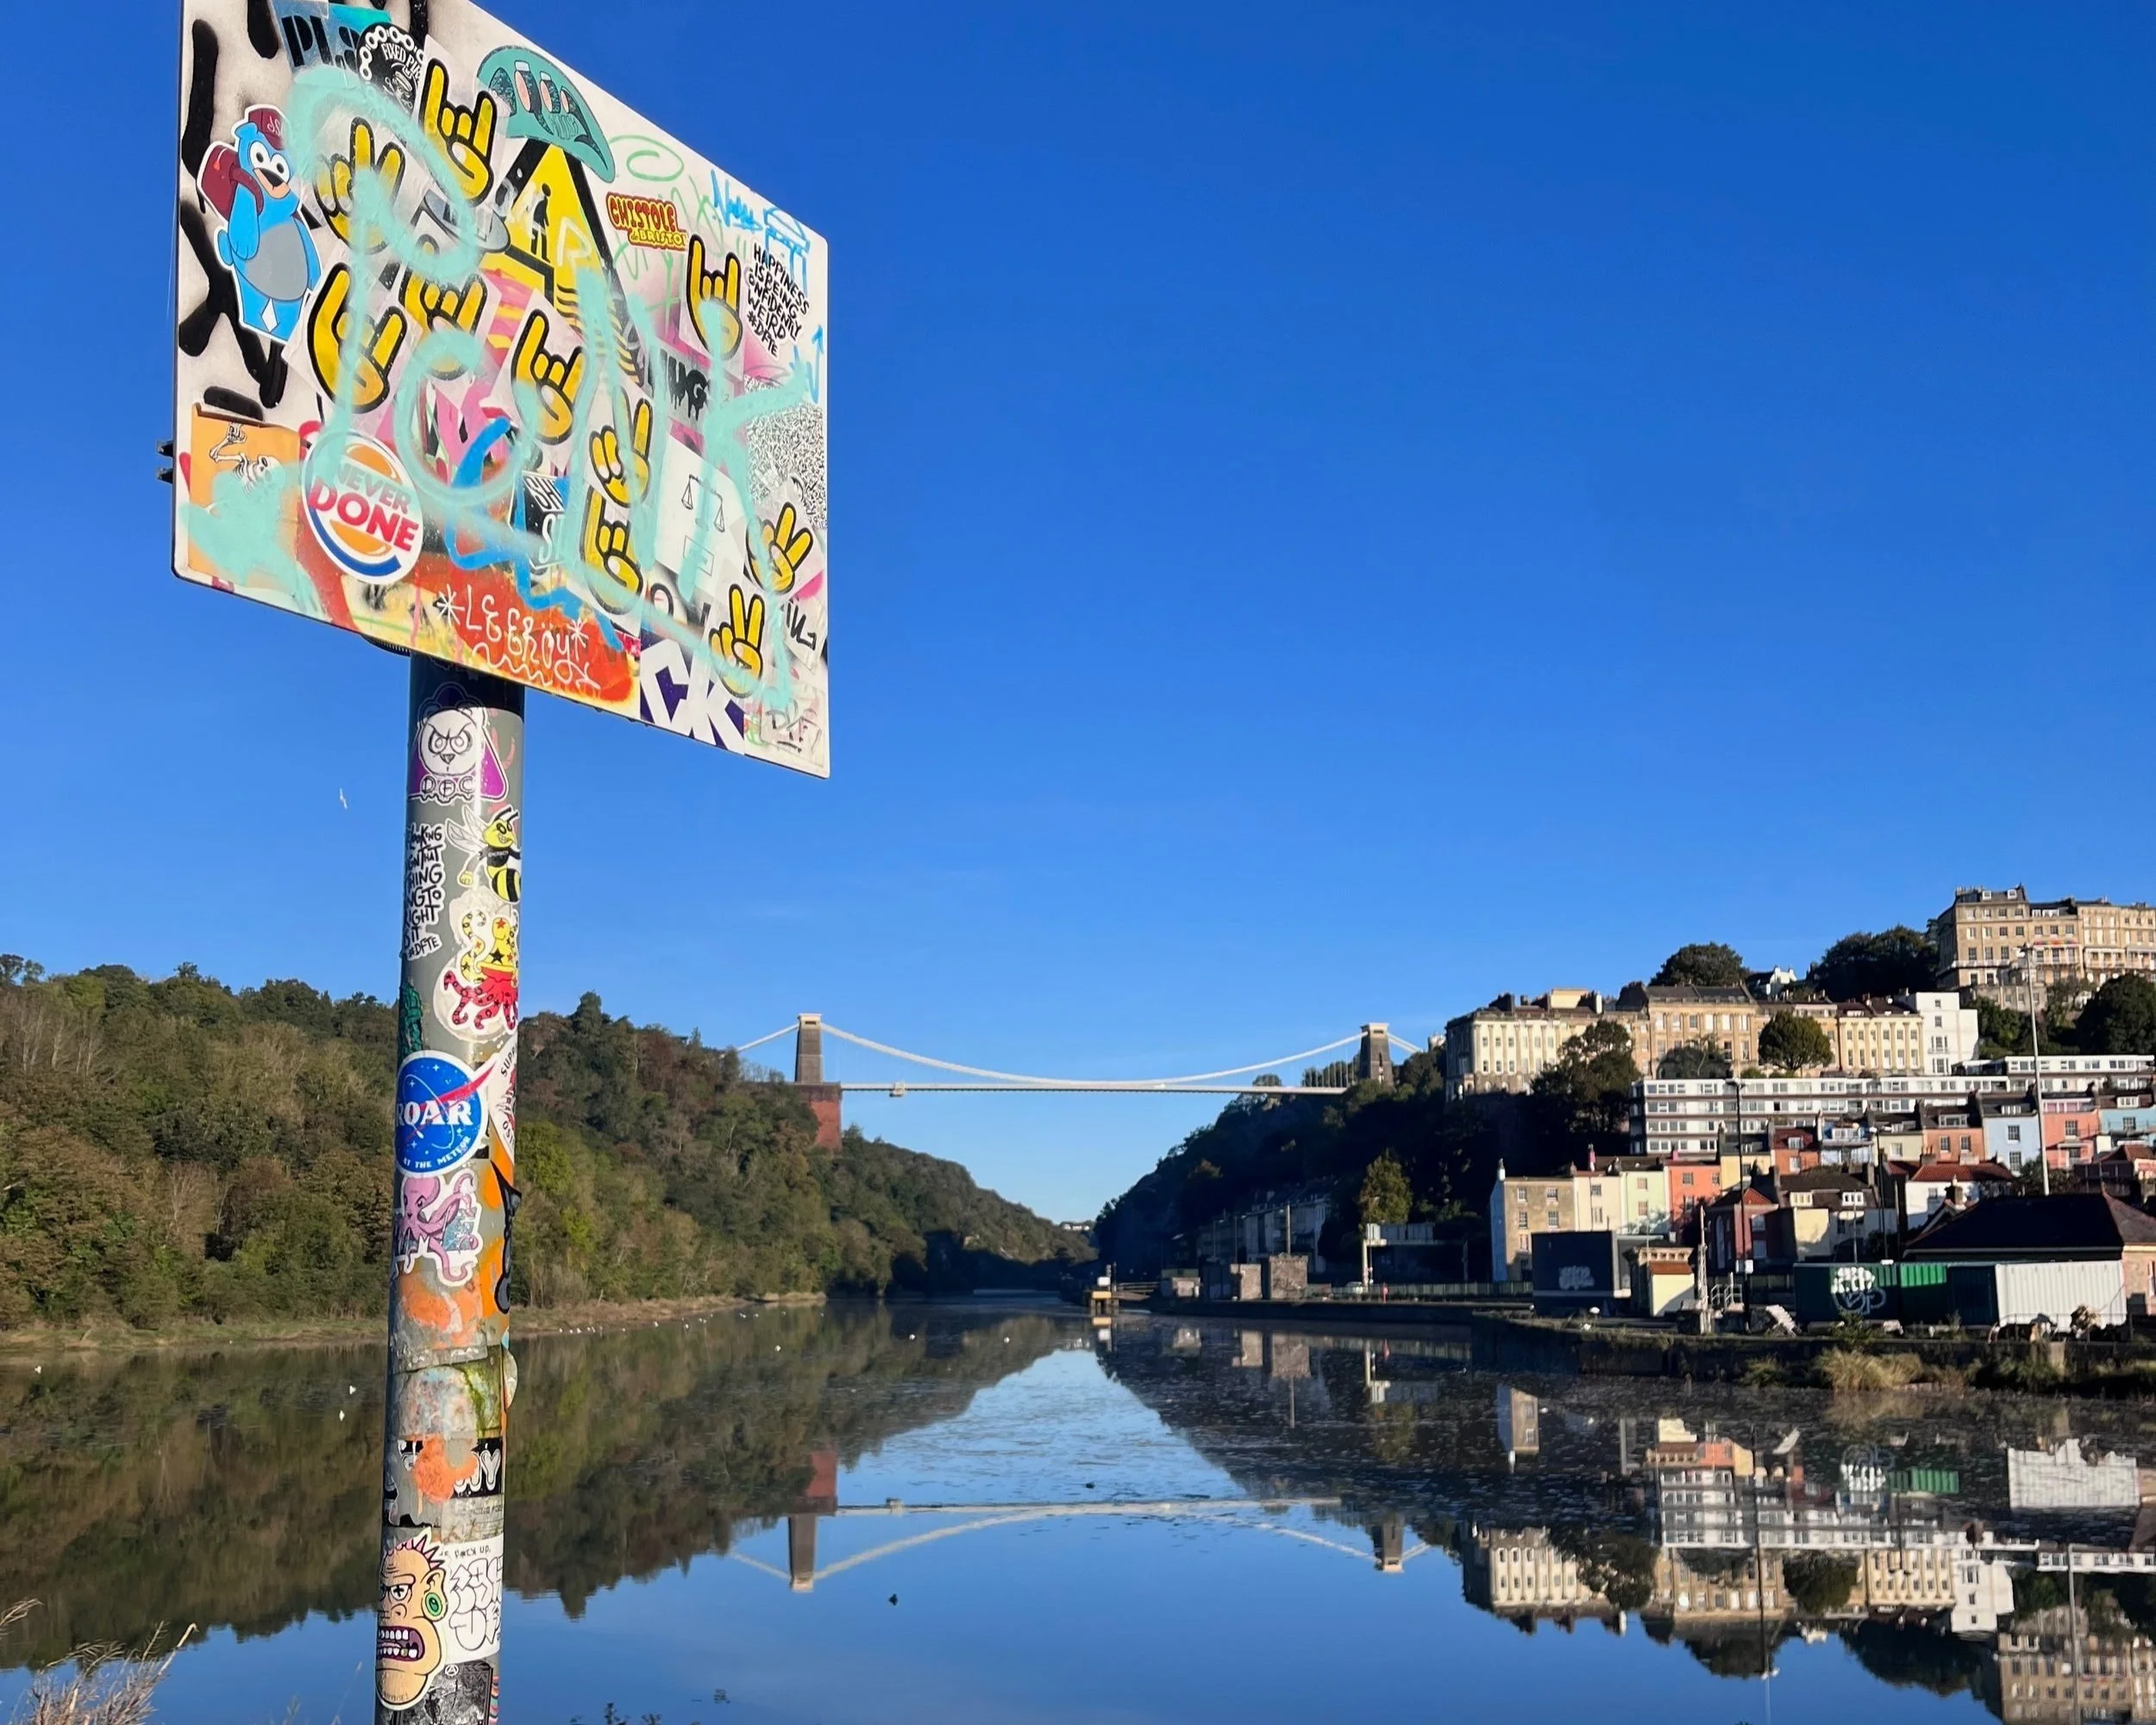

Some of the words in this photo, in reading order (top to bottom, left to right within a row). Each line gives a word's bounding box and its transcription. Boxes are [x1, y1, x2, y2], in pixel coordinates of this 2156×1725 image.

[381, 42, 406, 63] FIXED
[754, 242, 810, 315] HAPPINESS
[755, 262, 765, 282] IS
[764, 271, 799, 319] BEING
[748, 288, 787, 339] WEIRD
[337, 462, 411, 514] NEVER
[308, 476, 419, 552] DONE
[397, 1101, 473, 1126] ROAR
[415, 1160, 432, 1170] THE
[437, 1135, 472, 1165] METEOR
